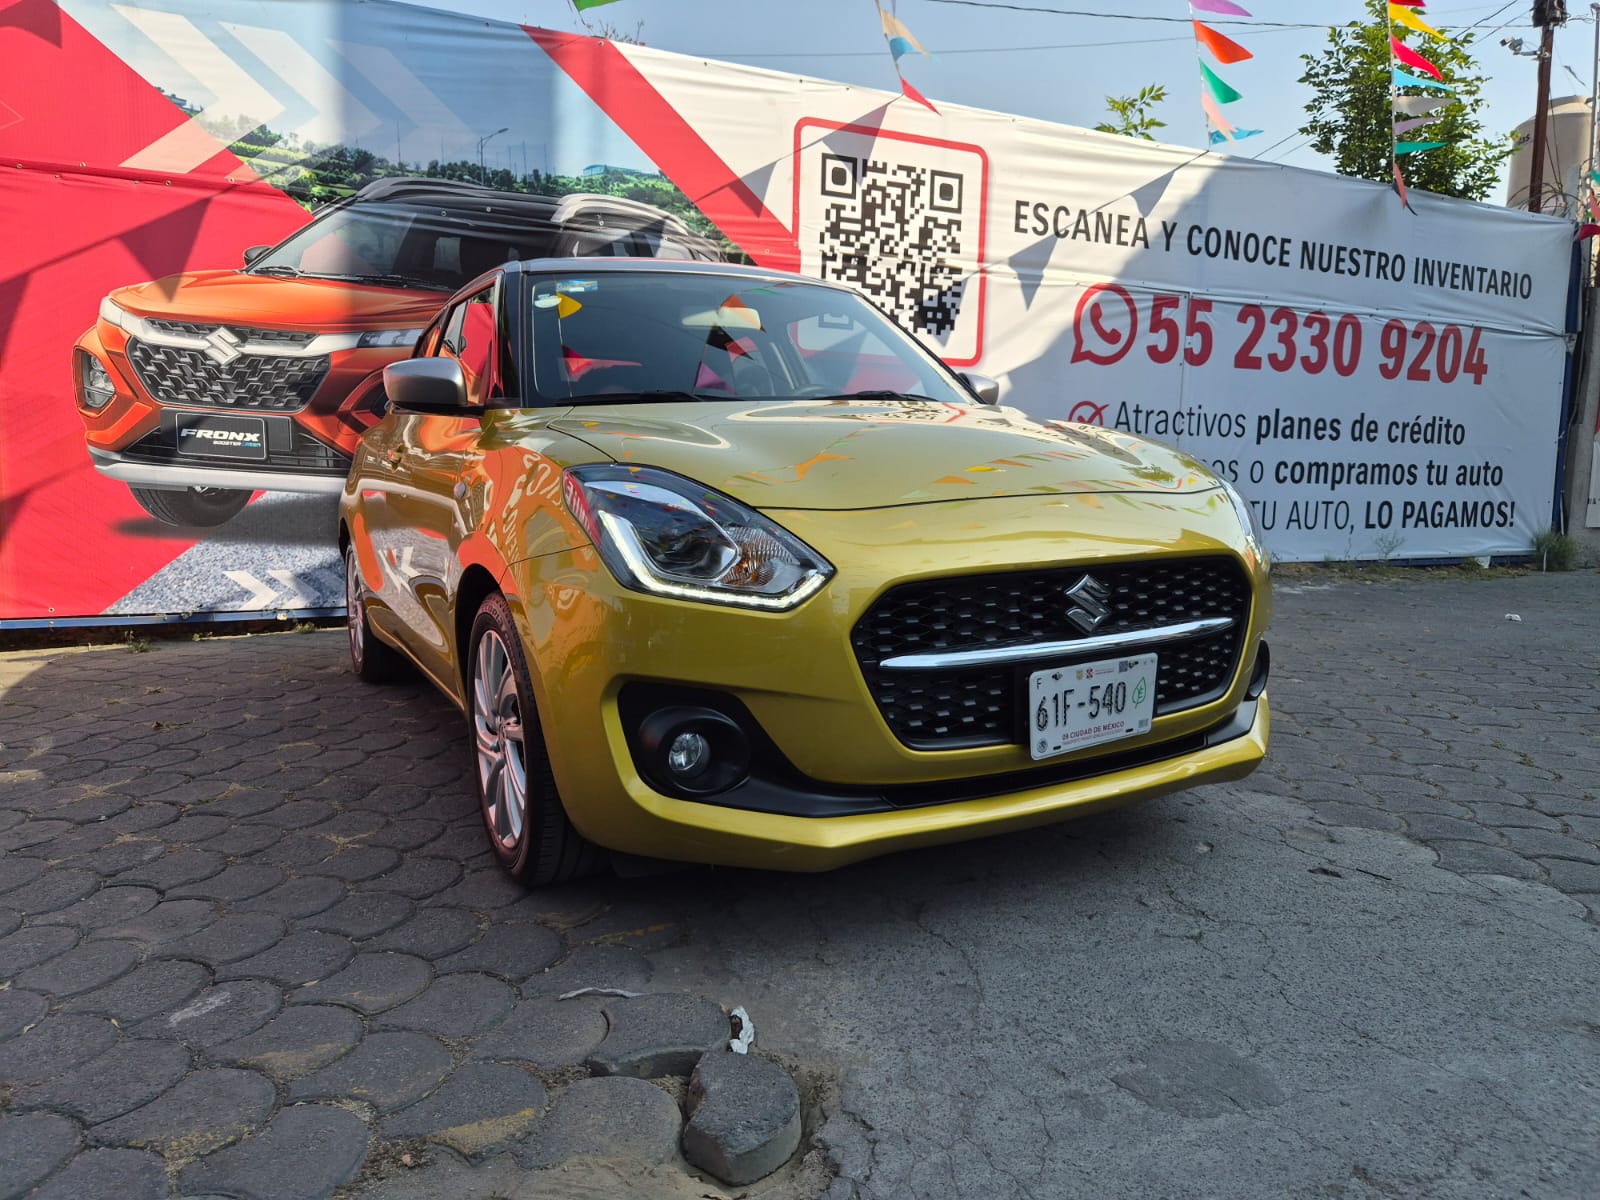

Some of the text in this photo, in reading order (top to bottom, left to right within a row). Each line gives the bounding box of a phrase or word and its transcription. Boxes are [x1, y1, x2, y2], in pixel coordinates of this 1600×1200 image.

[1014, 199, 1532, 299] ESCANEA Y CONOCE NUESTRO INVENTARIO
[1146, 295, 1488, 385] 55 2330 9204
[180, 428, 260, 442] FRONX
[1114, 400, 1466, 445] Atractivos planes de crédito
[1250, 460, 1264, 483] o
[1275, 460, 1418, 490] compramos
[1426, 459, 1448, 486] tu
[1455, 461, 1503, 486] auto
[1286, 501, 1355, 534] AUTO,
[1365, 501, 1393, 529] LO
[1402, 501, 1515, 529] PAGAMOS!
[1037, 681, 1126, 732] 61F-540
[1070, 727, 1093, 739] CIUDAD
[1093, 725, 1102, 734] DE
